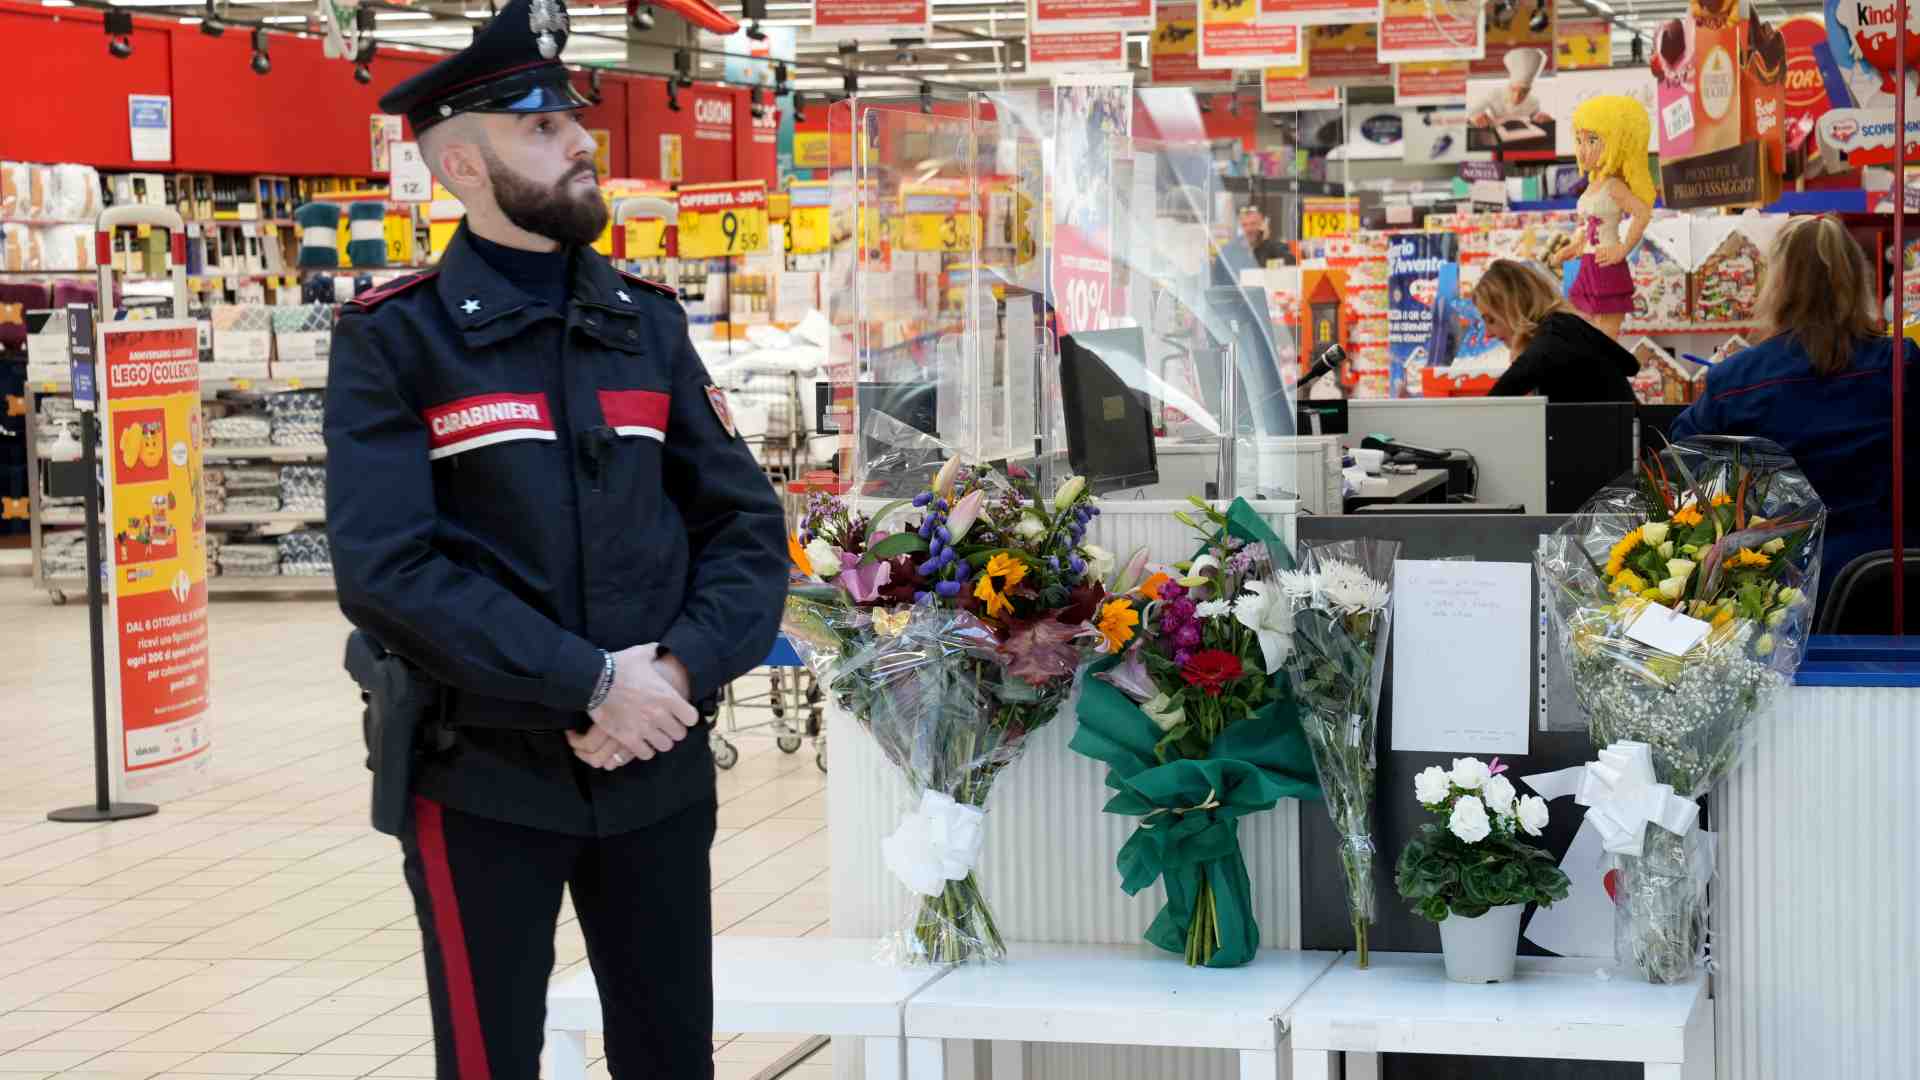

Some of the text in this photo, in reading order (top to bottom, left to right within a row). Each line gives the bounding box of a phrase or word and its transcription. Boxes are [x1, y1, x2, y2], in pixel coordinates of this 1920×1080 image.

[1857, 2, 1913, 26] kind
[681, 193, 734, 207] OFFERTA
[722, 211, 737, 250] 9
[113, 366, 148, 384] LEGO
[432, 402, 540, 435] CARABINIERI
[126, 621, 144, 633] DAL
